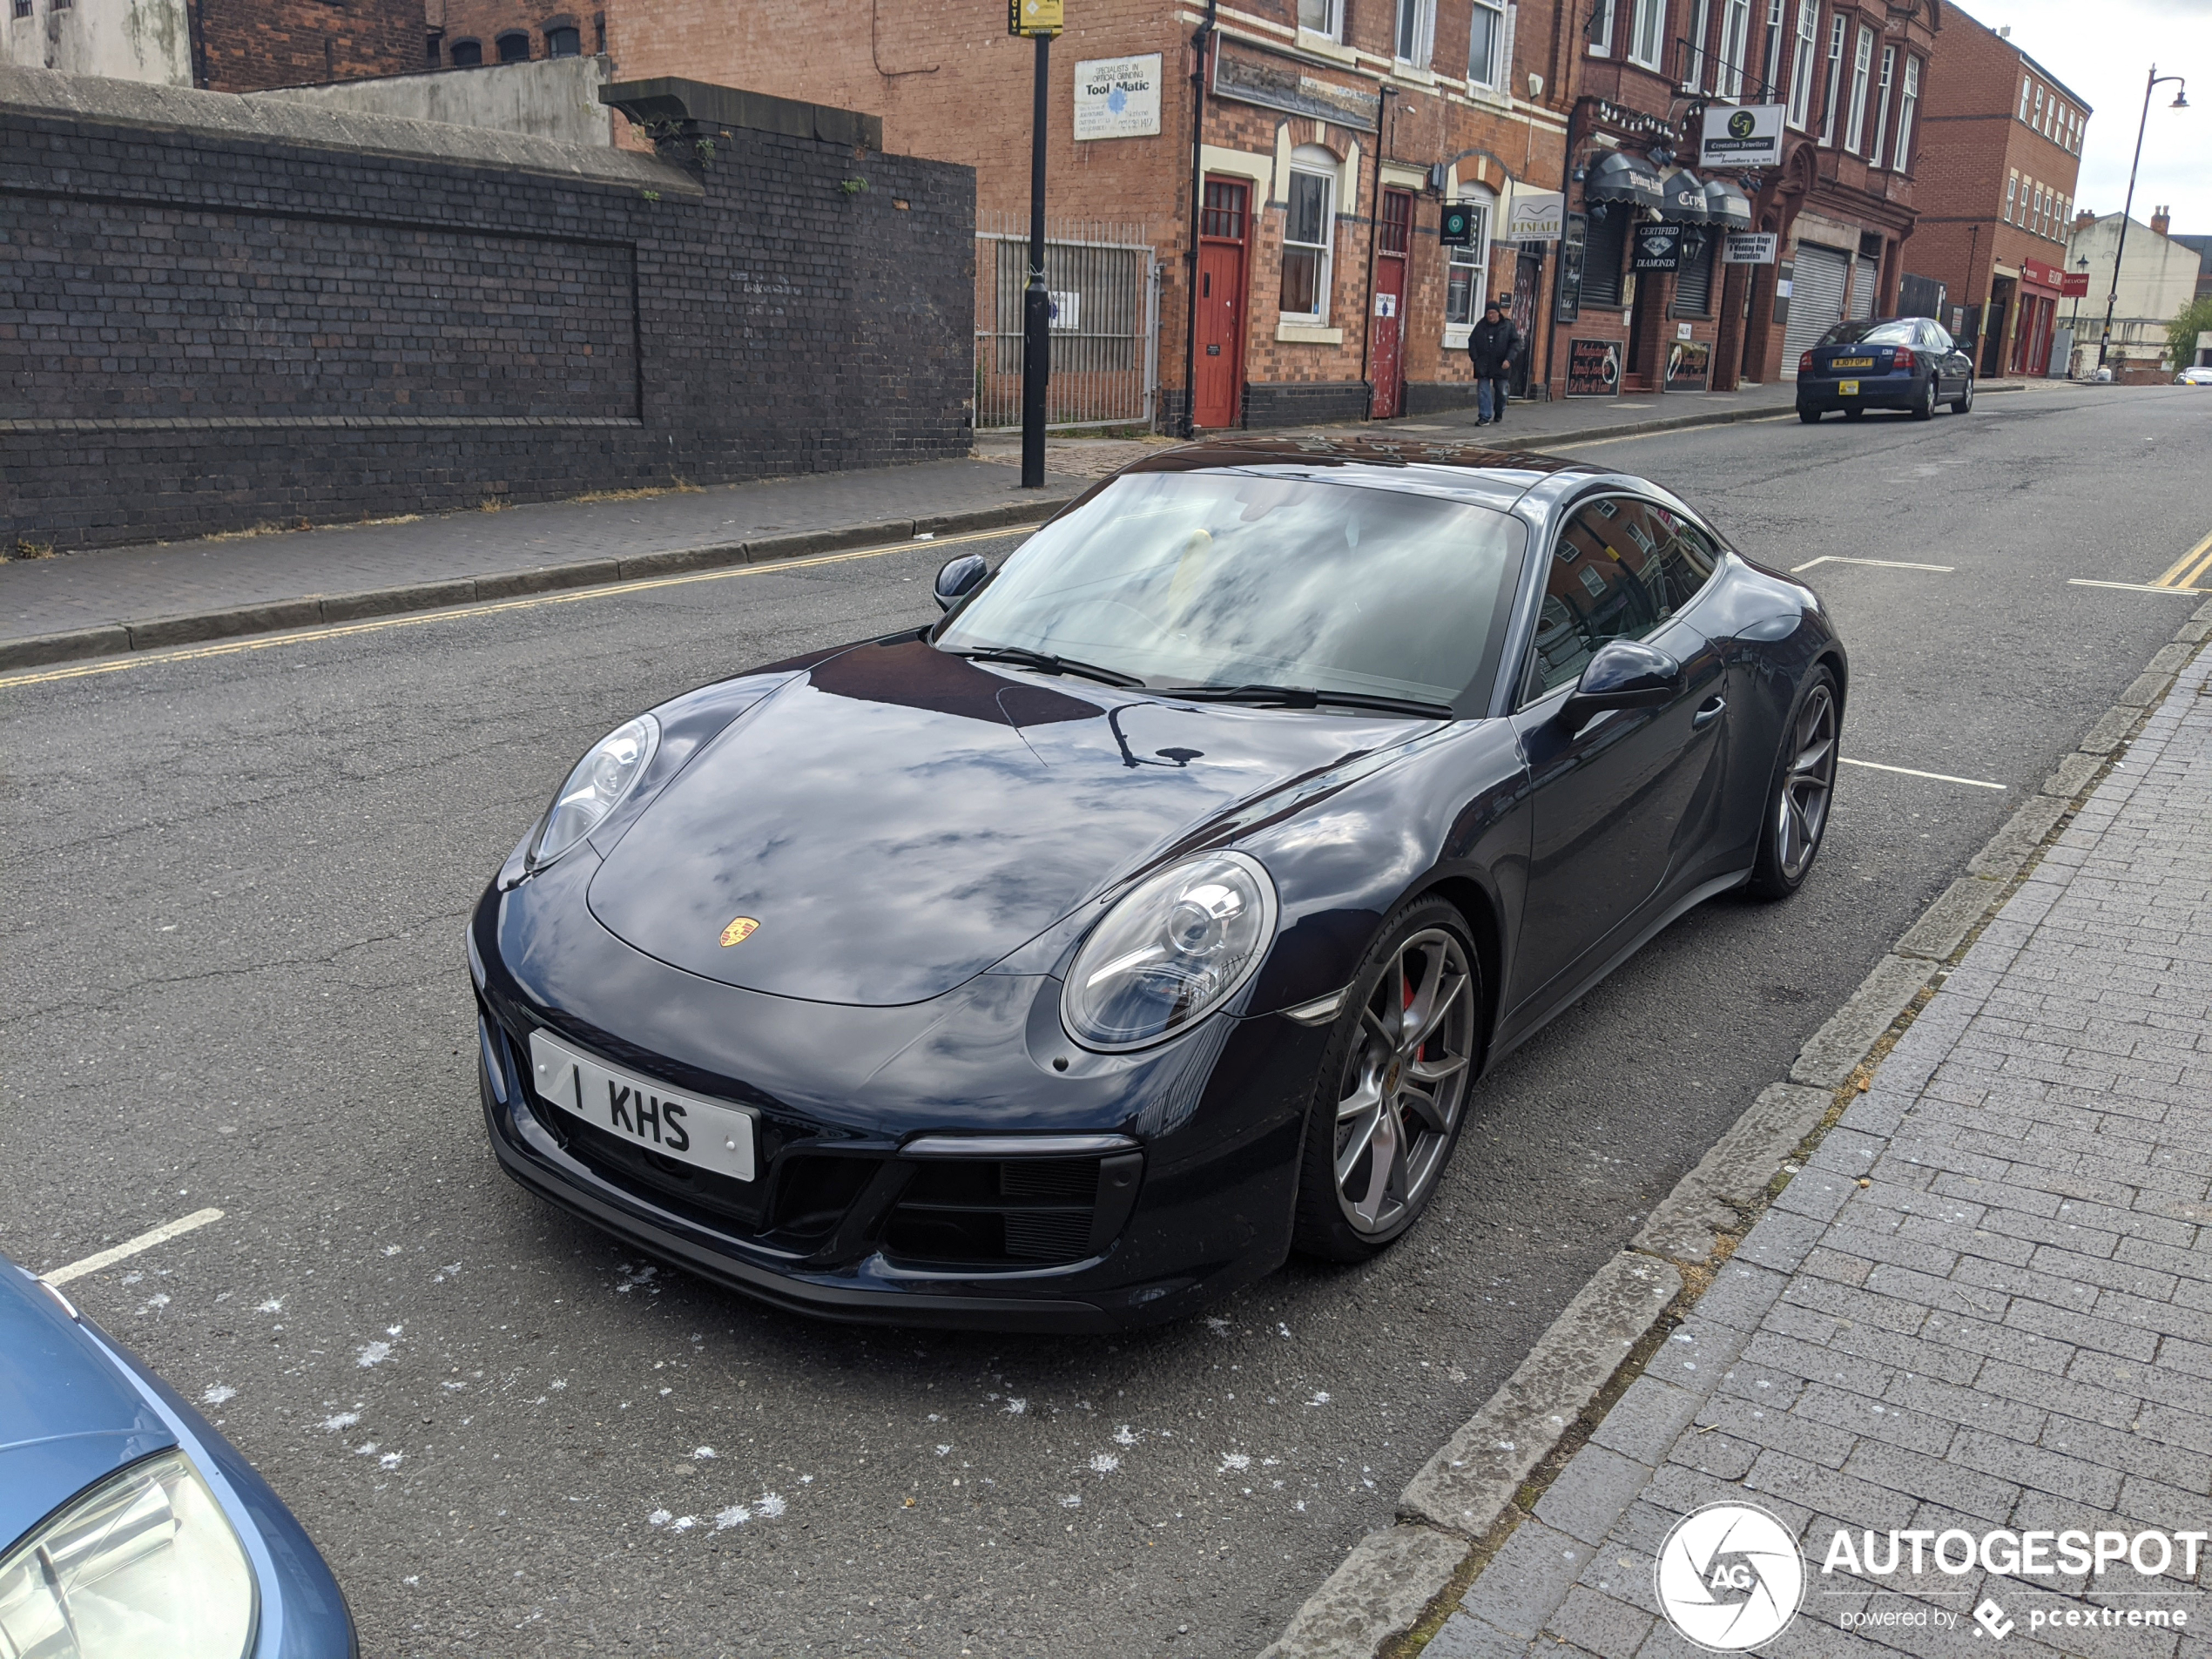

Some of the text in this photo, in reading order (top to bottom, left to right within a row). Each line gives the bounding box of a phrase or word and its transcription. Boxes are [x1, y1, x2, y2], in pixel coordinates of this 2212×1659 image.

[1096, 63, 1139, 75] SPECIALISTS IN
[1092, 71, 1143, 83] OPTICAL GRINDING
[1086, 80, 1150, 96] Tool Matic
[1629, 171, 1651, 191] Wedding
[1512, 221, 1560, 233] RESHAPE
[1640, 226, 1679, 235] CERTIFIED
[1727, 236, 1771, 245] Engagement Rings
[1756, 245, 1767, 253] Ring
[1636, 259, 1676, 267] DIAMONDS
[1572, 361, 1590, 378] Family
[1578, 379, 1590, 392] Over
[608, 1079, 690, 1152] KHS
